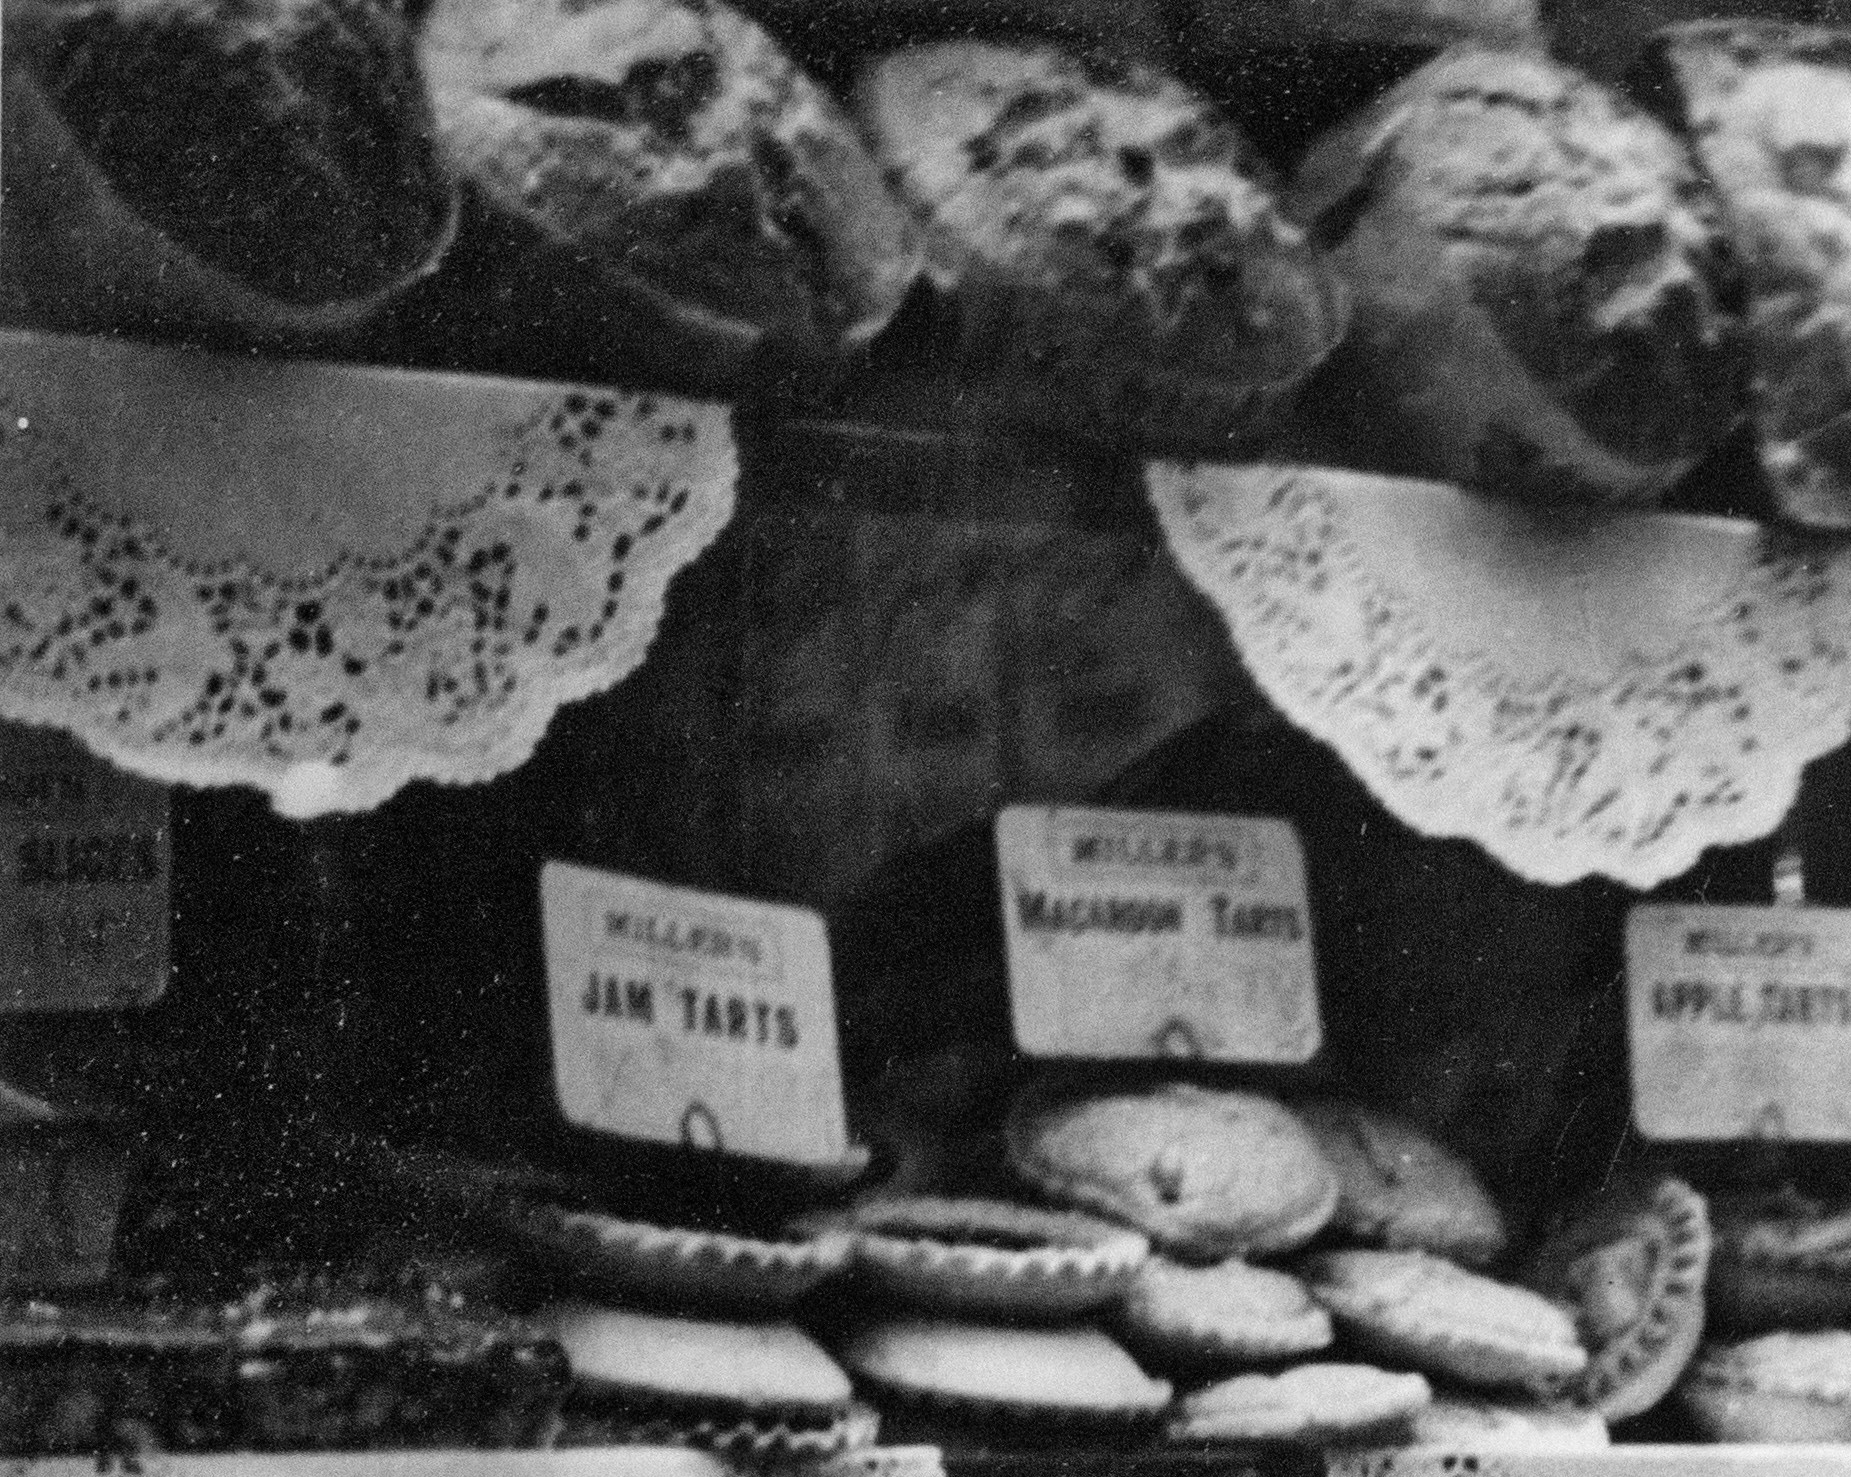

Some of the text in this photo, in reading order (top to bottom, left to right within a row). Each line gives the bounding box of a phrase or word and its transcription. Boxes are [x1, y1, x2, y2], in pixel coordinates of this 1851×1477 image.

[604, 909, 763, 966] MILLER'S
[582, 971, 800, 1051] JAM TARTS
